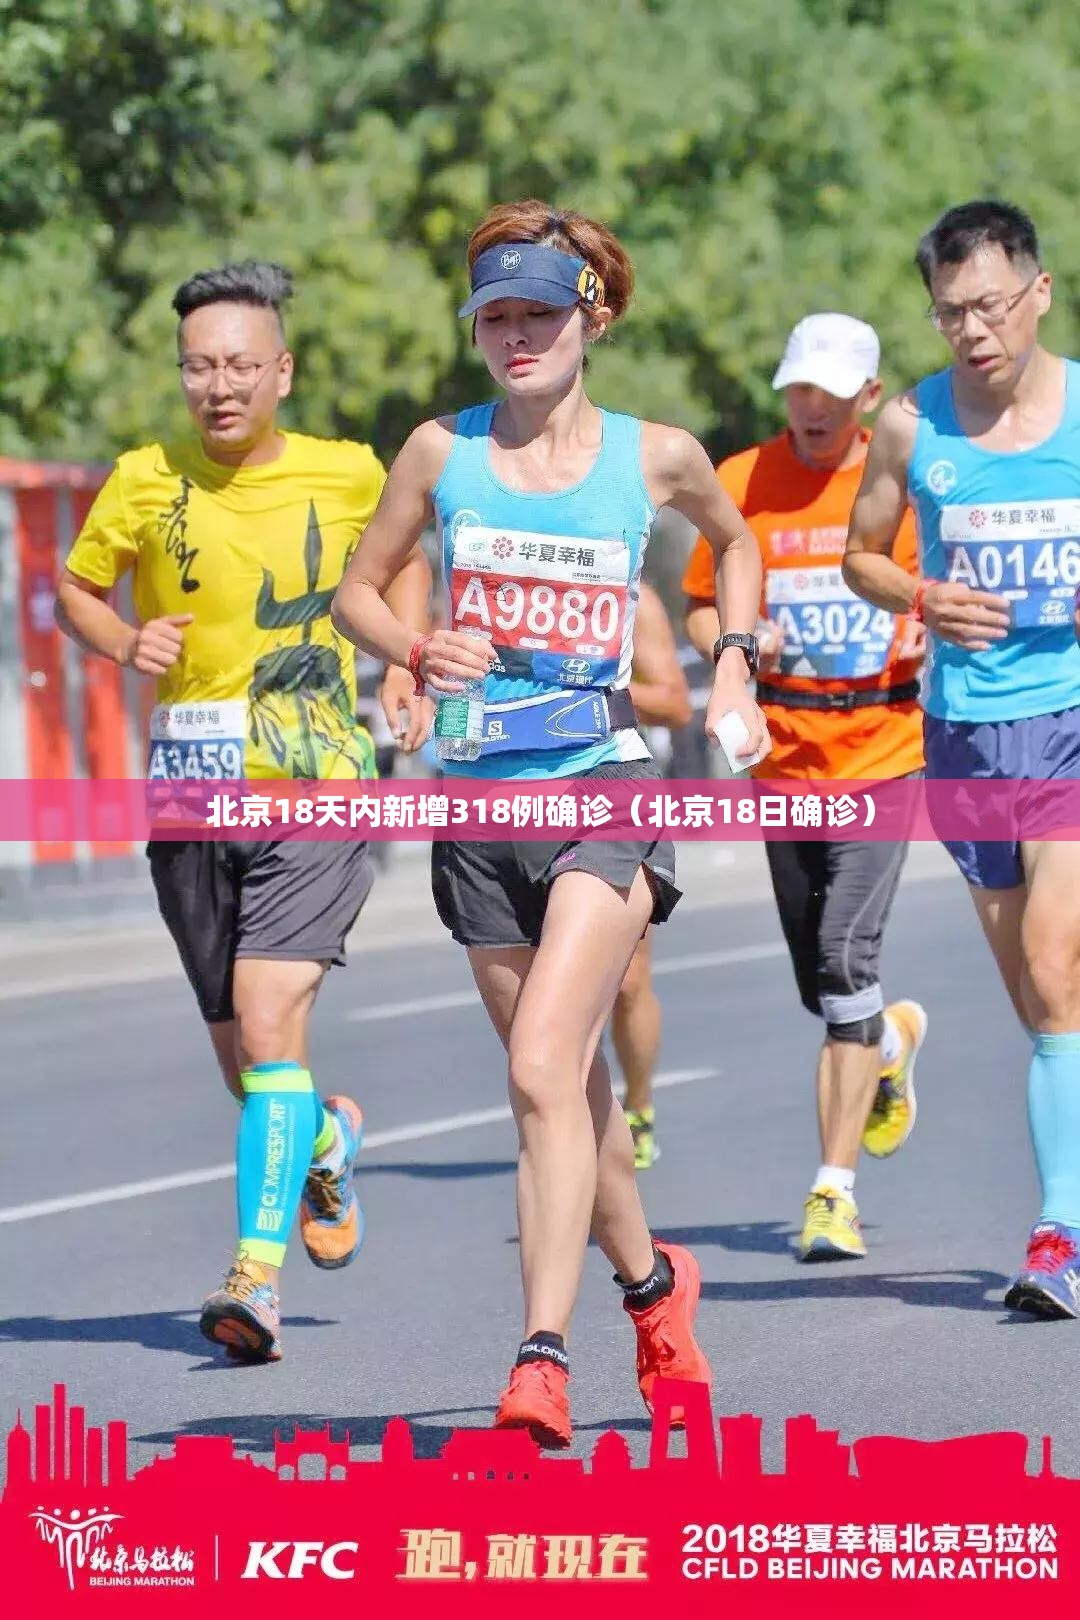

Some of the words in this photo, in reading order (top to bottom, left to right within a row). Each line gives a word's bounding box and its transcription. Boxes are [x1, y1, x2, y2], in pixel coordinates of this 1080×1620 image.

[518, 541, 595, 567] 华夏幸福
[950, 542, 1080, 589] A0146
[454, 577, 619, 642] A9880
[777, 602, 894, 645] A3024
[149, 742, 242, 784] A3459
